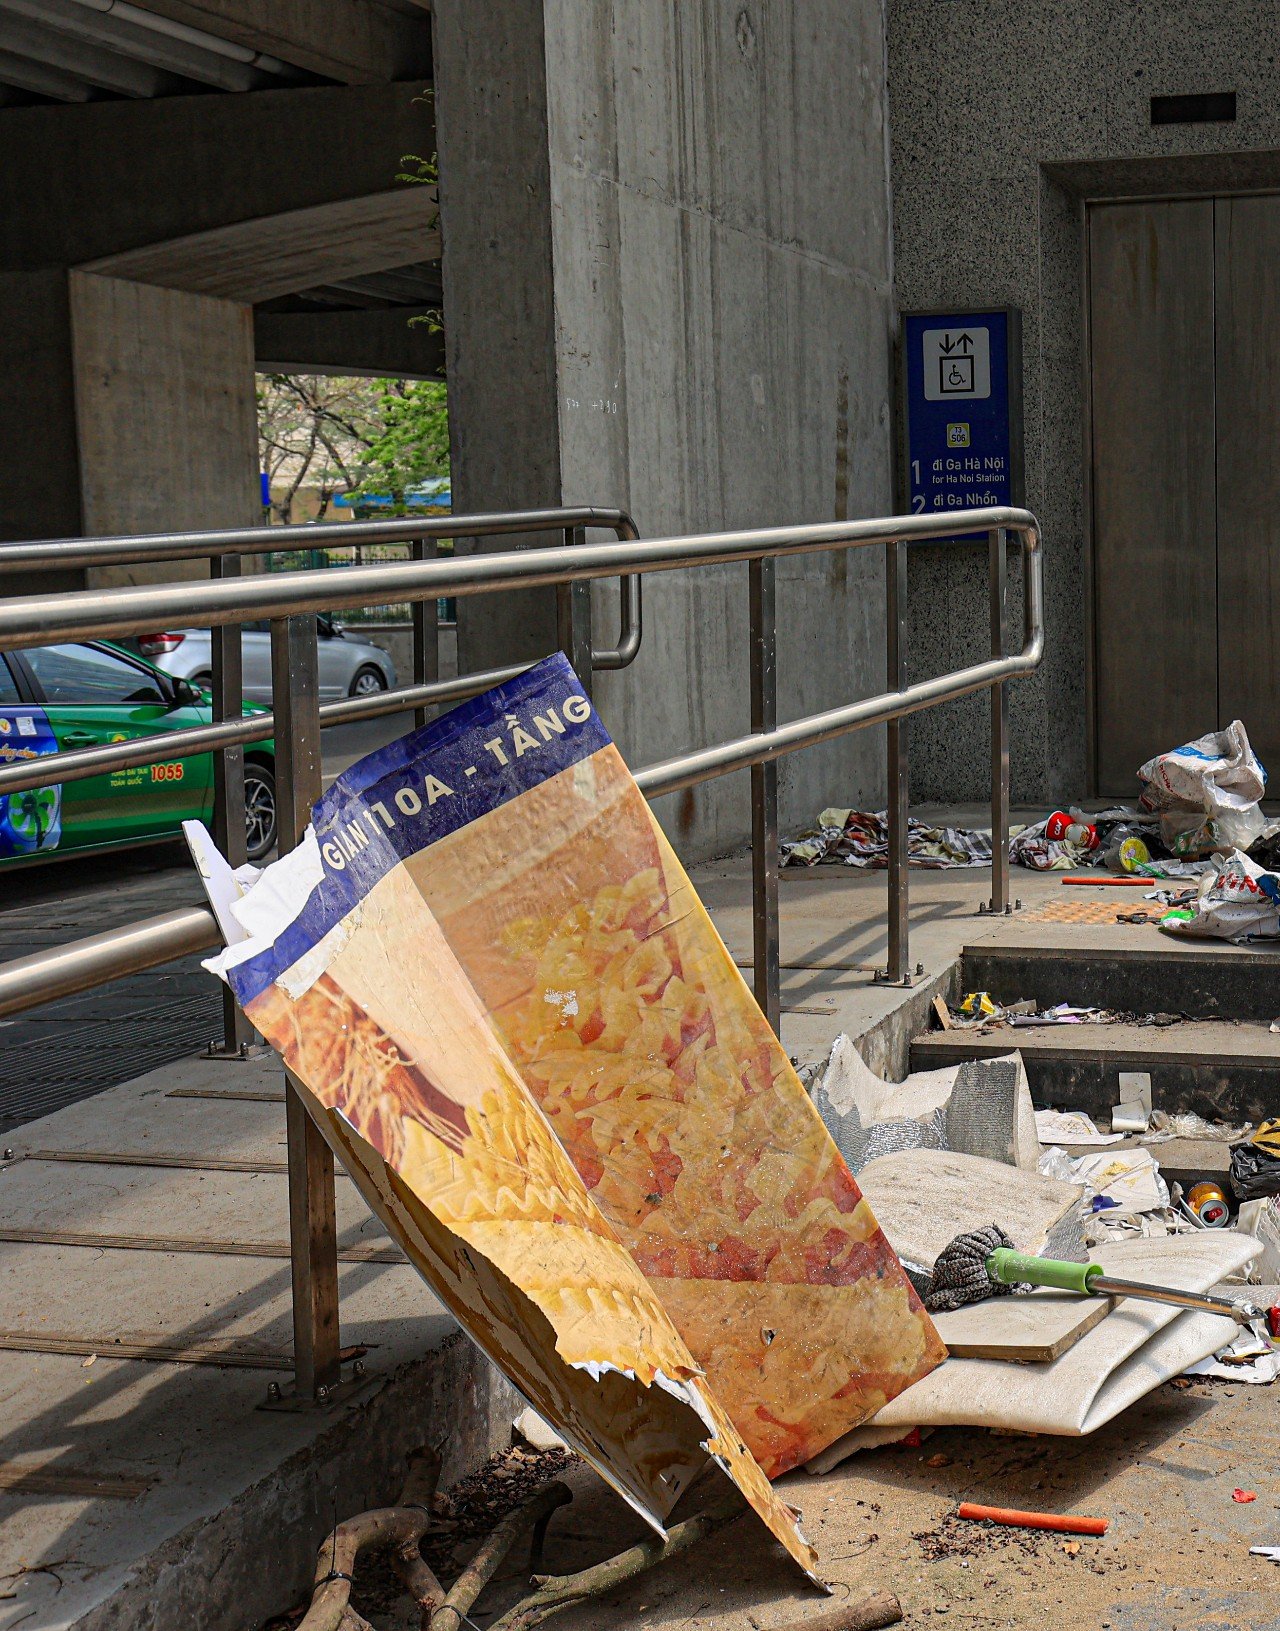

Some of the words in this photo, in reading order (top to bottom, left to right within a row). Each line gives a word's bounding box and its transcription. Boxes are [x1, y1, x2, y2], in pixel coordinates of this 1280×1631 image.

[951, 434, 966, 443] S06
[911, 459, 921, 485] 1
[932, 459, 943, 471] đi
[946, 458, 961, 470] Ga
[965, 457, 981, 470] Hà
[984, 456, 1004, 472] Nội
[932, 475, 945, 484] for
[946, 474, 958, 483] Ha
[959, 473, 974, 483] Noi
[975, 473, 1005, 482] Station
[933, 494, 944, 506] đi
[947, 493, 963, 506] Ga
[966, 490, 998, 506] Nhổn
[151, 762, 184, 782] 1055
[322, 819, 370, 871] GIAN
[362, 773, 455, 836] 110A
[484, 695, 591, 767] TẦNG
